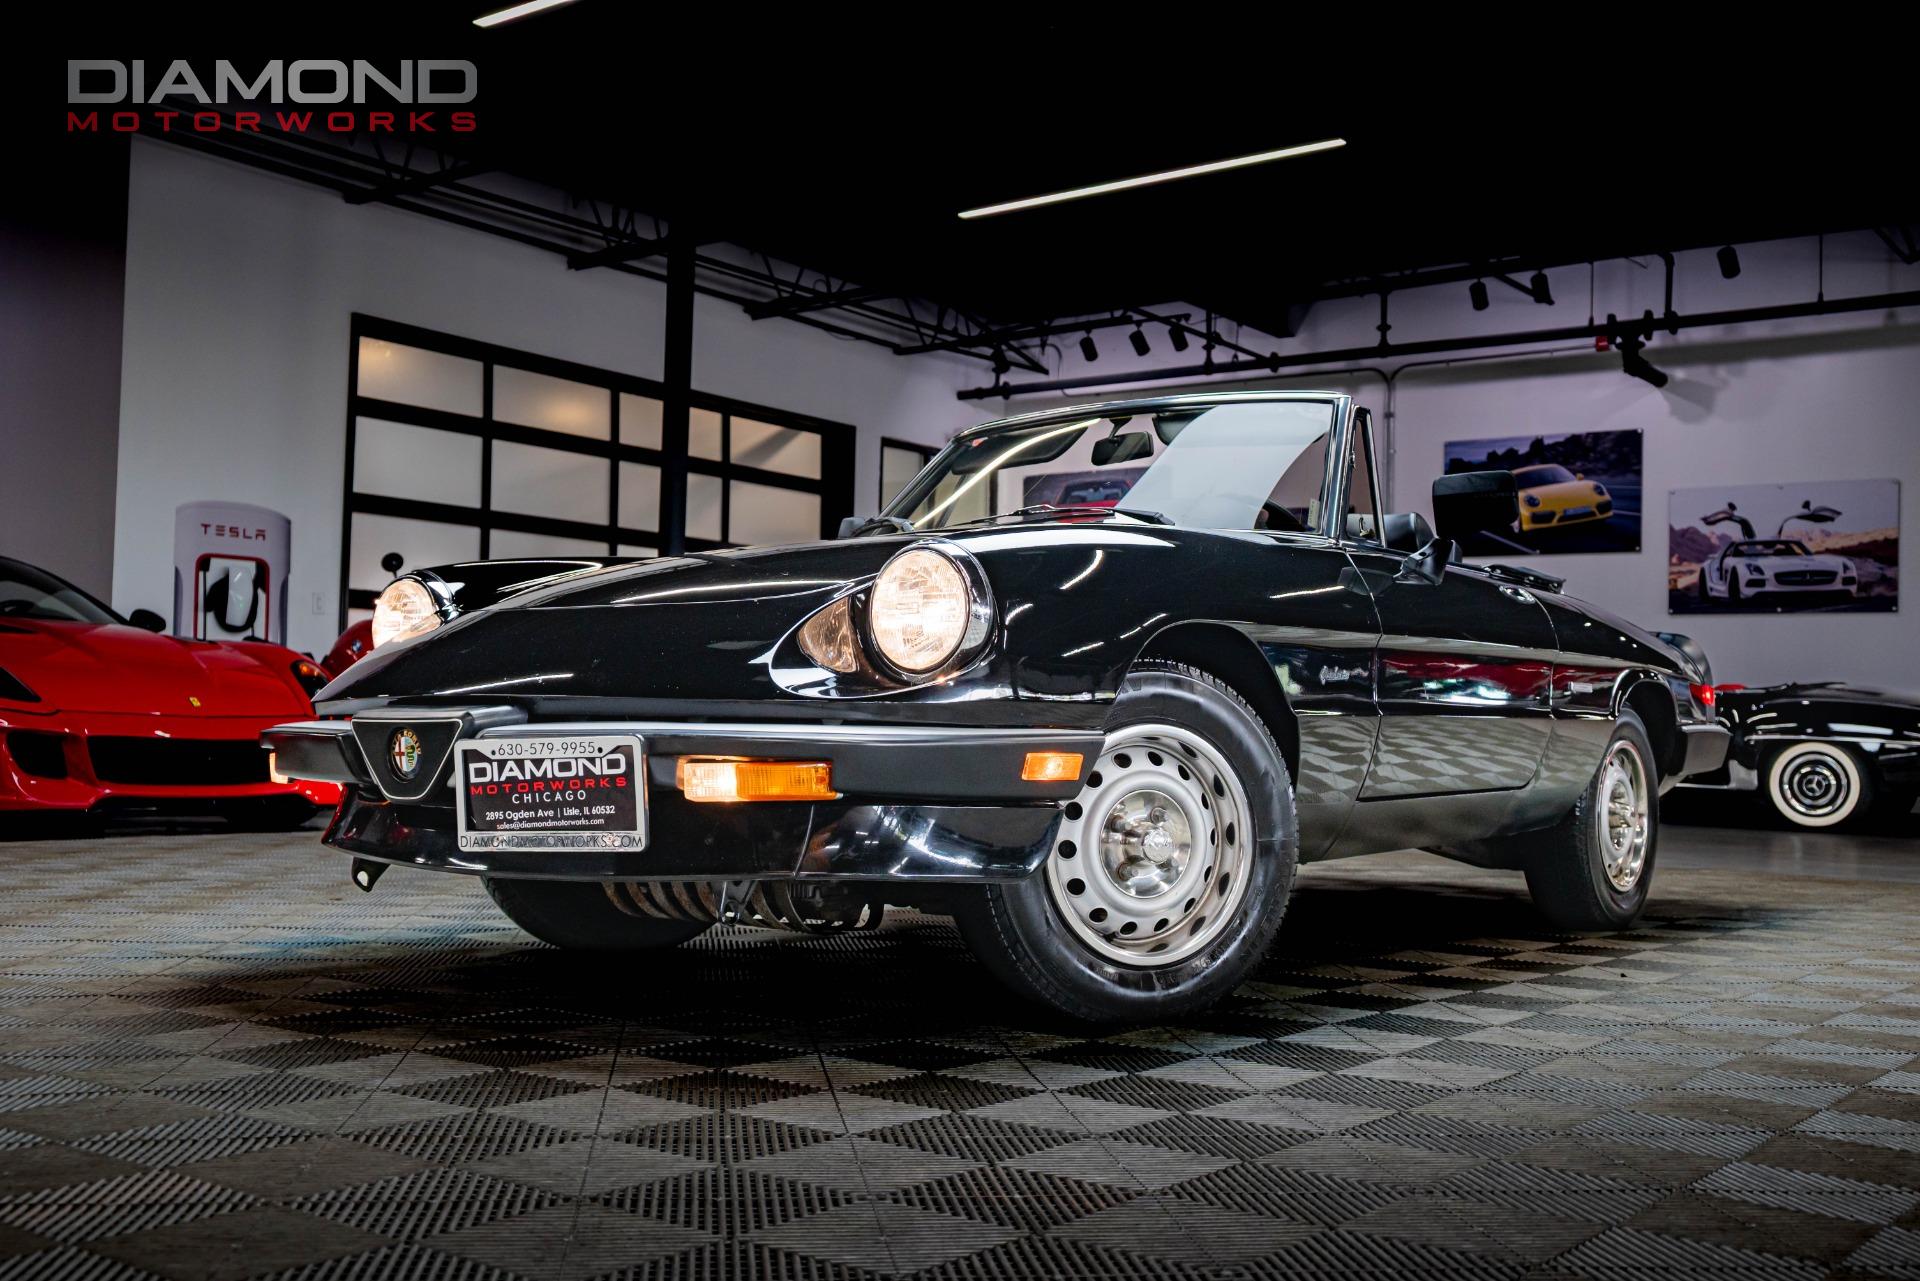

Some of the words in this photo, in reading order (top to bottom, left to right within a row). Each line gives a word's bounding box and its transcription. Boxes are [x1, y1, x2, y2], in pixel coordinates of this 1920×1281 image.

[200, 523, 267, 541] TESLA
[498, 742, 596, 756] 630-579-9955
[468, 753, 627, 784] DIAMOND
[470, 776, 628, 796] MOTORWORKS
[512, 790, 587, 804] CHICAGO
[485, 811, 504, 821] 2895
[505, 810, 535, 821] Ogden
[537, 809, 554, 818] Ave
[563, 807, 582, 816] Lisle,
[583, 806, 590, 815] IL
[591, 805, 616, 815] 60532
[496, 818, 605, 830] sales@diamondmotorworks.com
